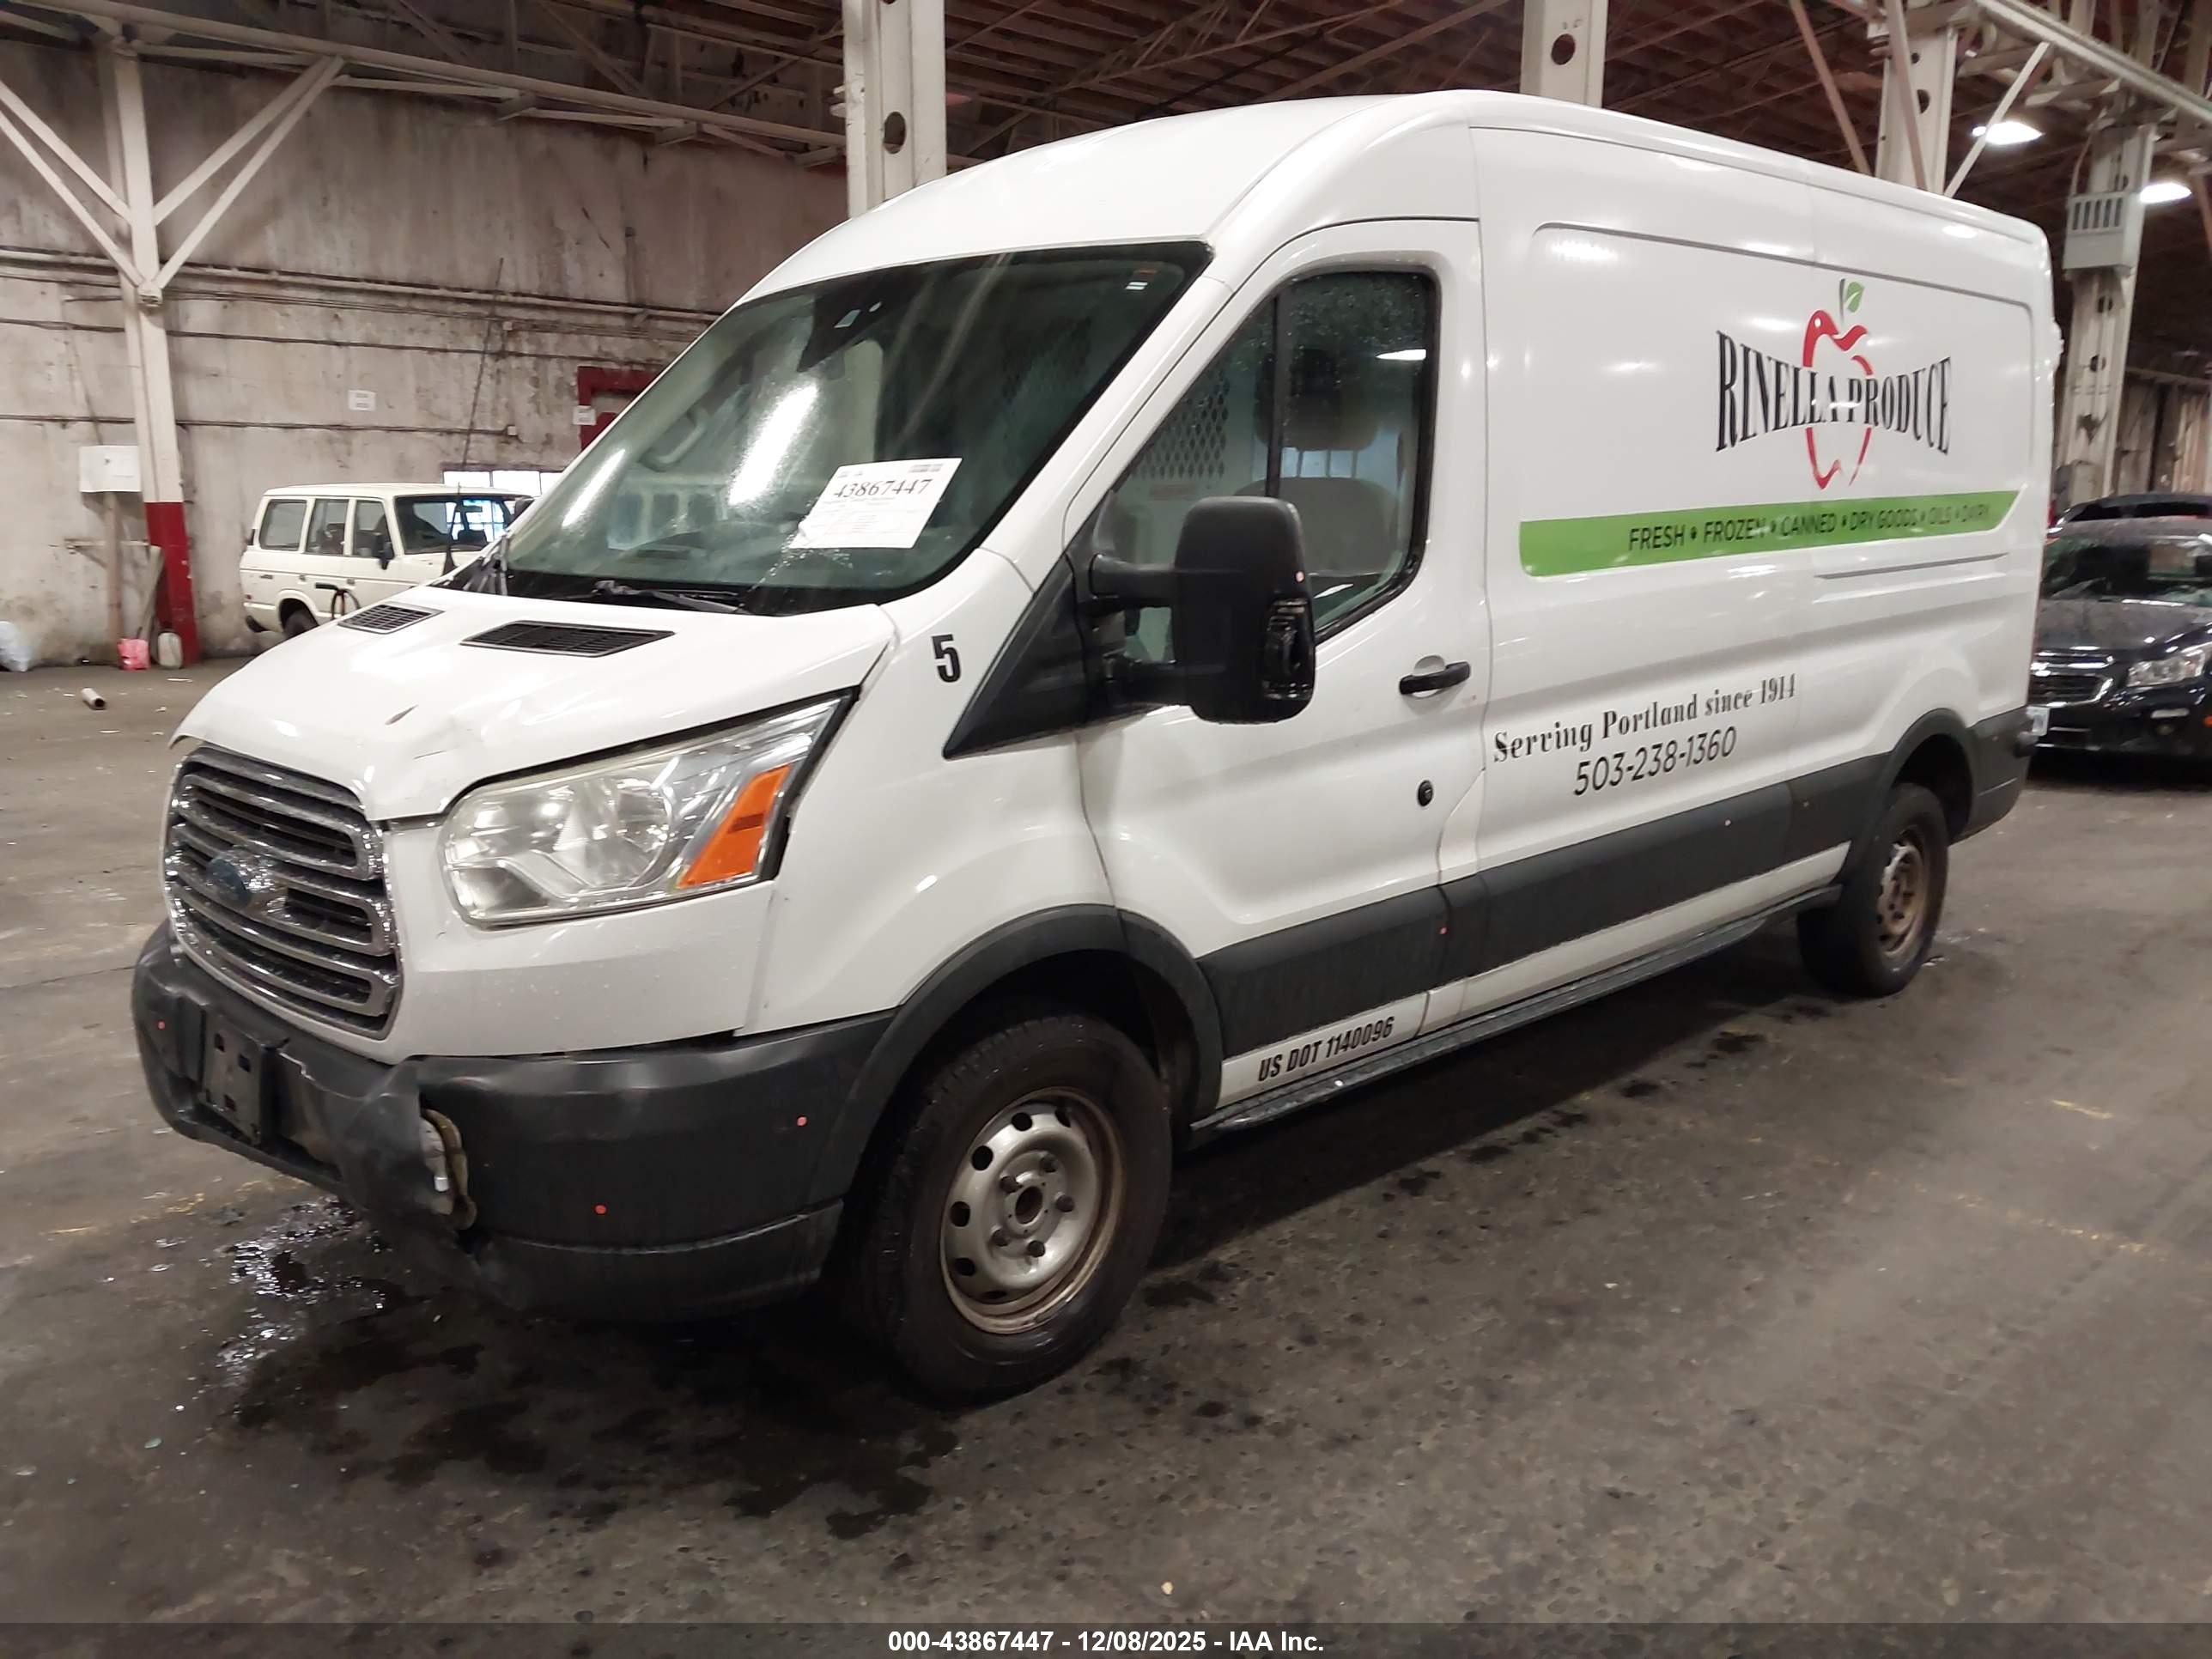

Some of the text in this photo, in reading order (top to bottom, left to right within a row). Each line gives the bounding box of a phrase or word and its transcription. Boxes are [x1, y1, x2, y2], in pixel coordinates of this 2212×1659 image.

[1716, 330, 1951, 456] RINELLA PRODUCE
[834, 478, 933, 498] 43867447
[1629, 525, 1686, 550] FRESH
[1704, 518, 1765, 543] FROZEN
[932, 634, 961, 683] 5
[1494, 721, 1592, 763] Serving
[1601, 693, 1698, 739] Portland
[1705, 688, 1753, 716] since
[1574, 726, 1737, 796] 503-238-1360
[1258, 1017, 1395, 1082] US DOT 1140096
